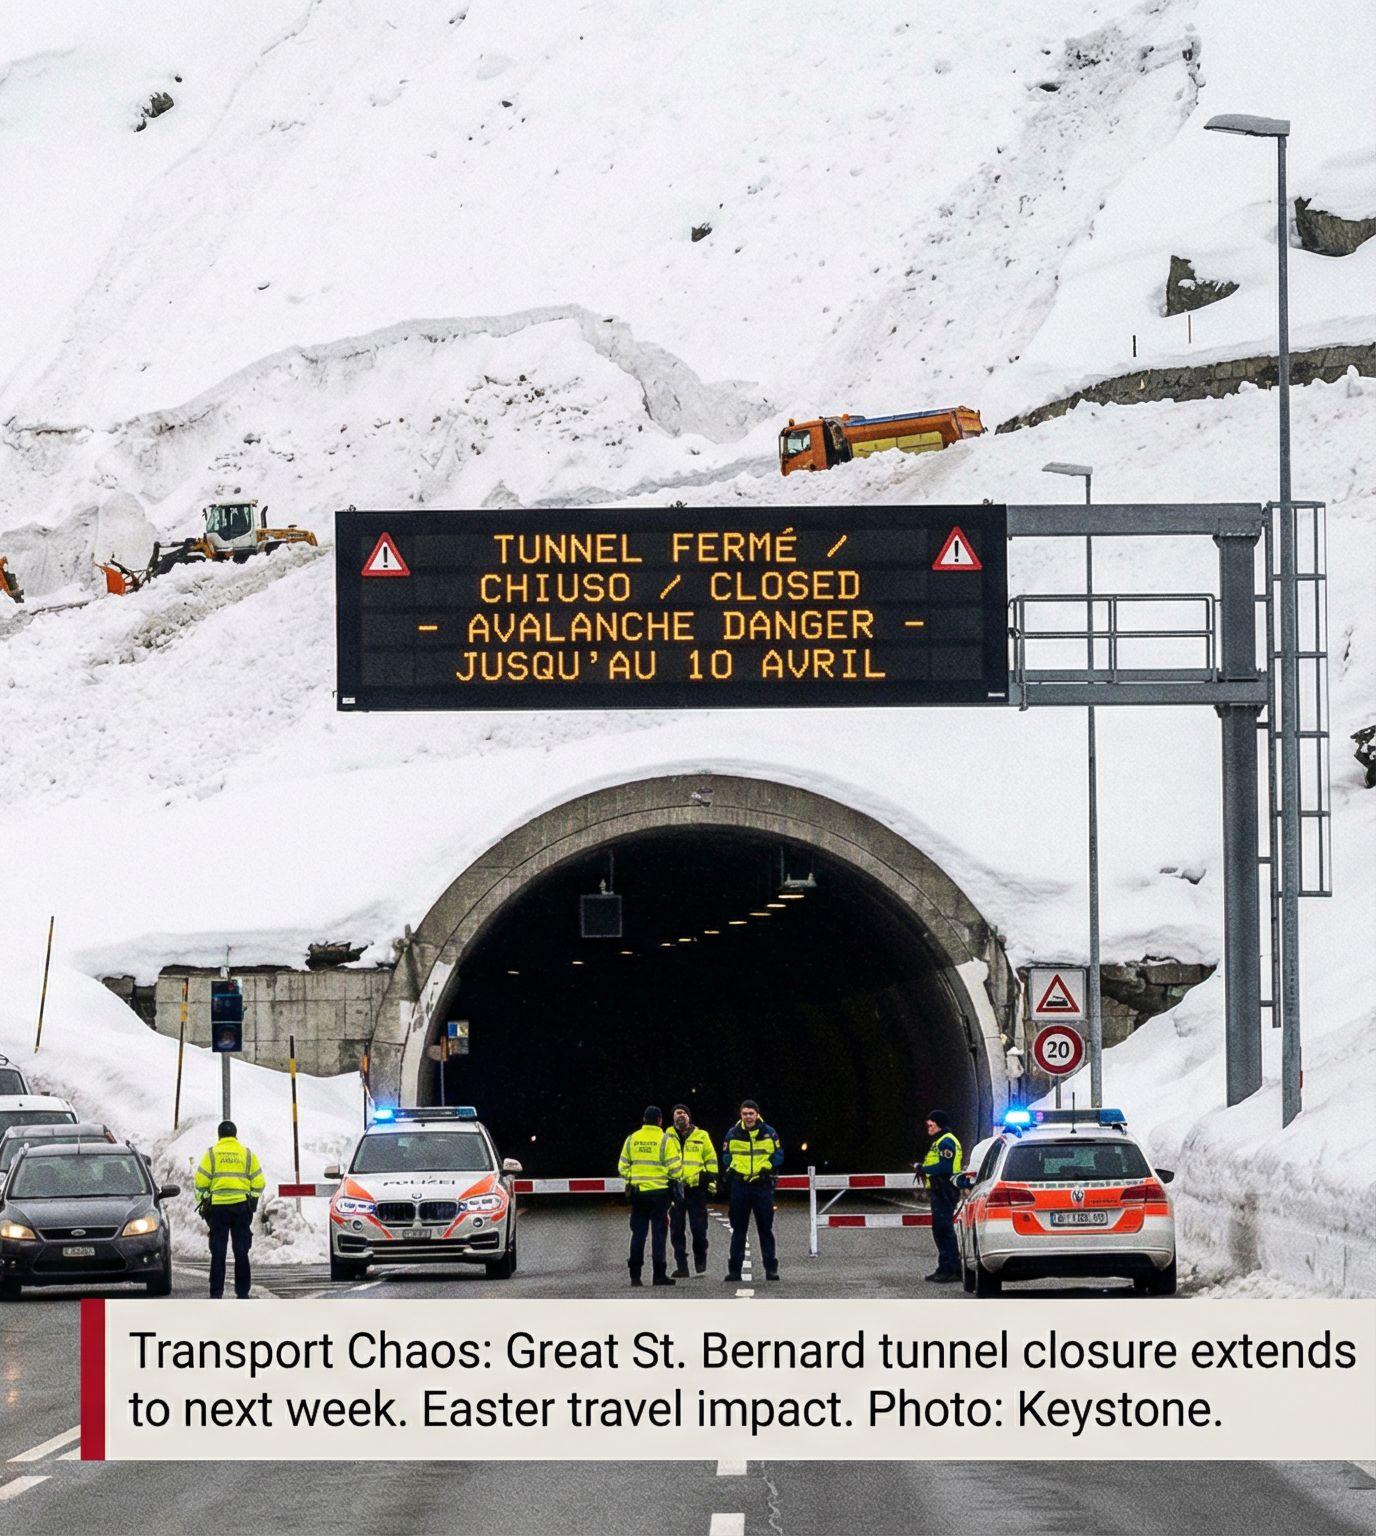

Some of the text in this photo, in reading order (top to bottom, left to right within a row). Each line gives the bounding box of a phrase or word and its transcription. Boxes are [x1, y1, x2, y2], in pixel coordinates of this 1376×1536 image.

[493, 527, 848, 564] TUNNEL FERMÉ /
[480, 570, 861, 604] CHIUSO / CLOSED
[468, 611, 695, 644] AVALANCHE
[723, 609, 874, 642] DANGER
[455, 648, 886, 682] JUSQU'AU 10 AVRIL
[1047, 1040, 1070, 1059] 20
